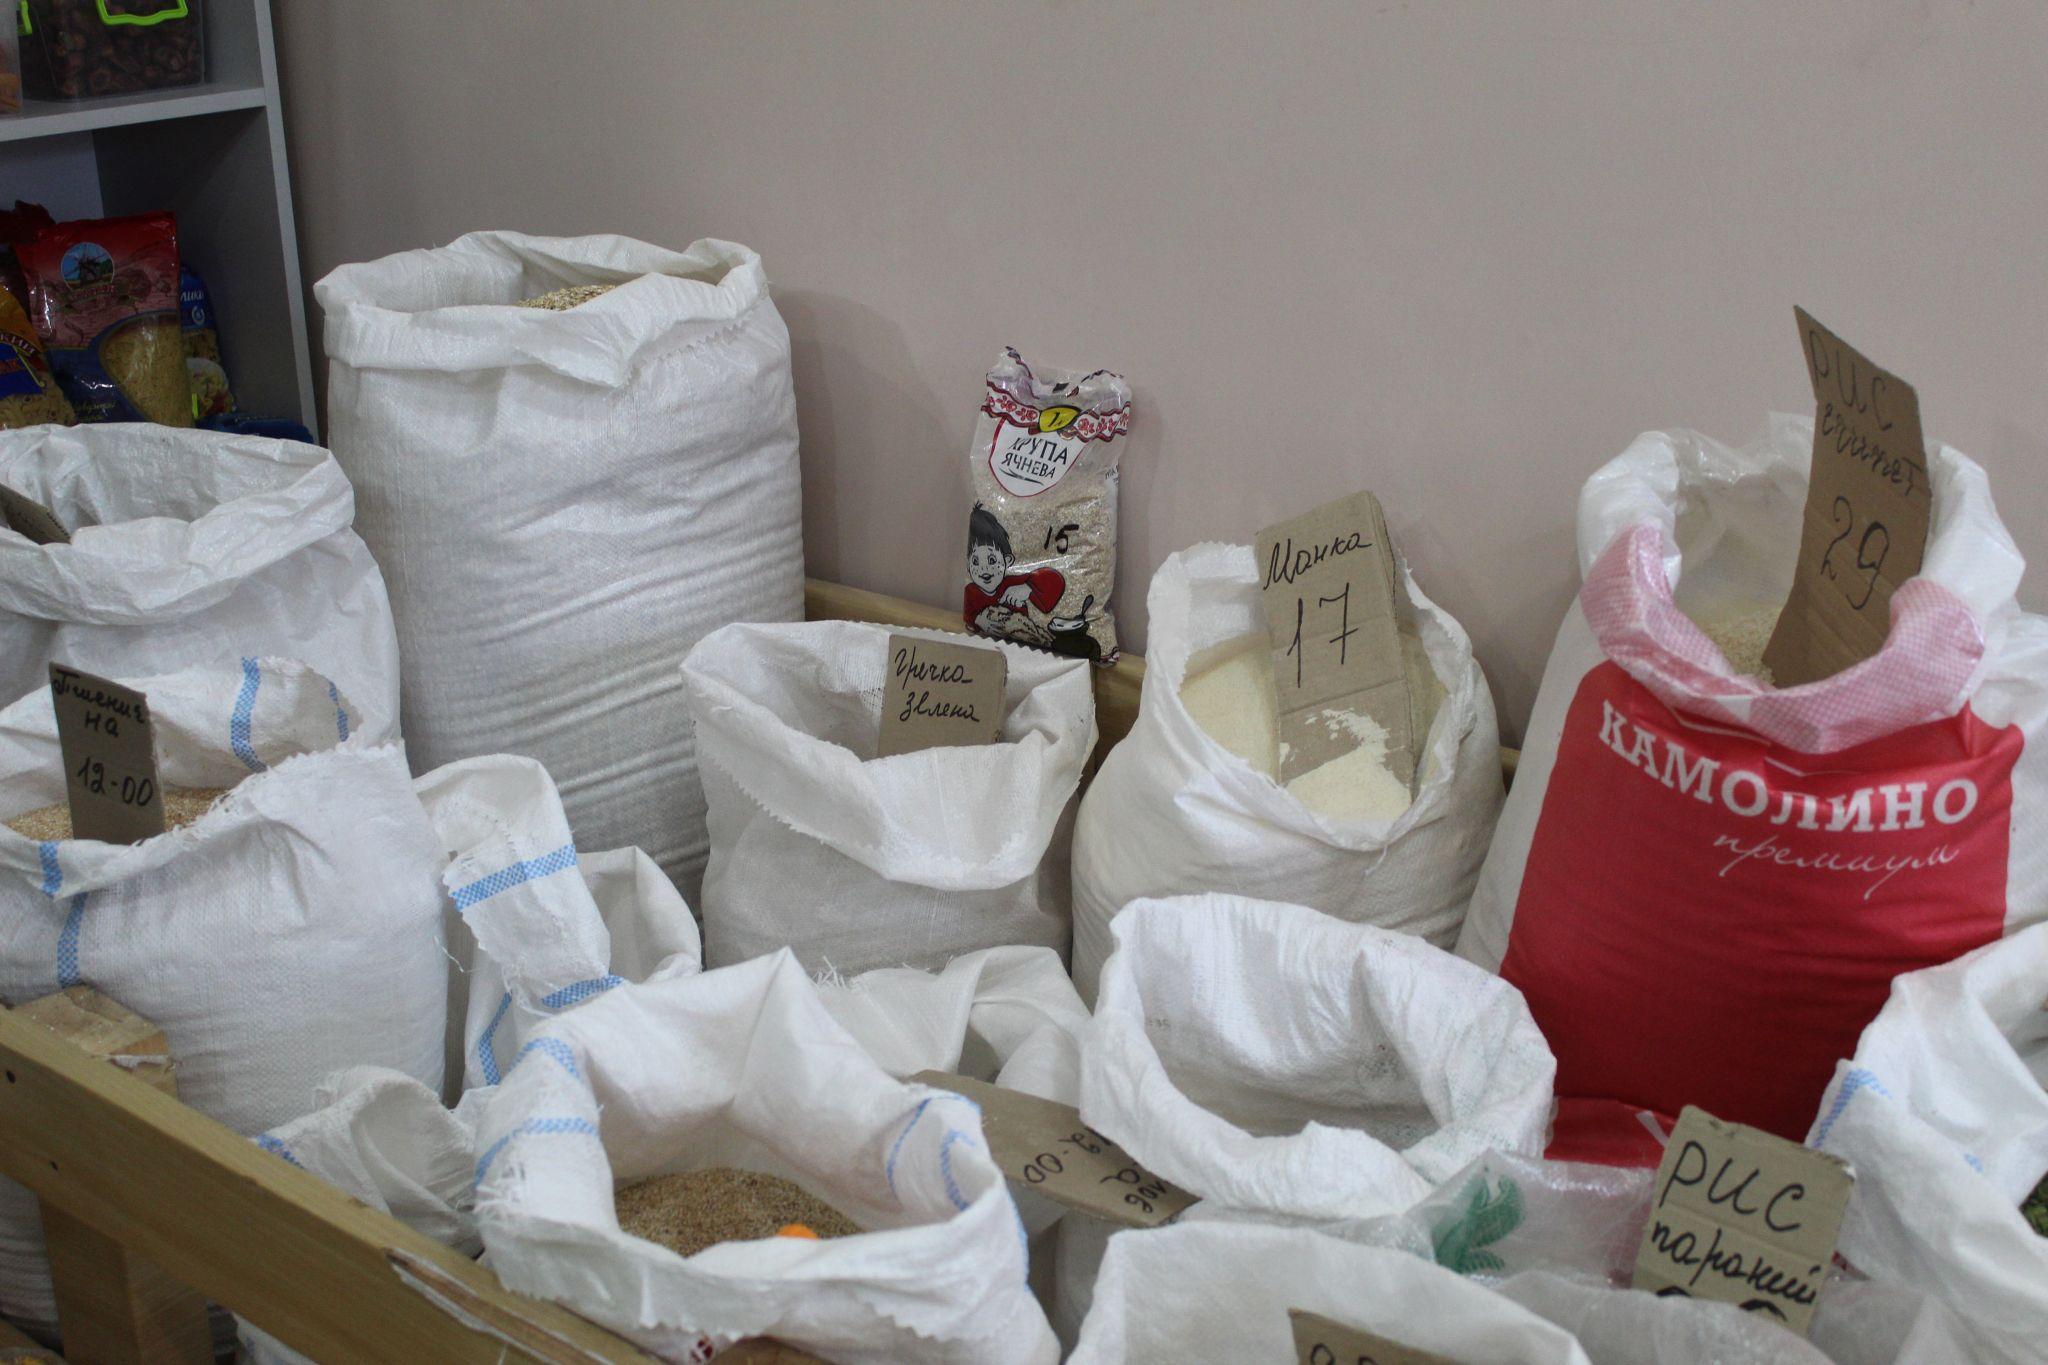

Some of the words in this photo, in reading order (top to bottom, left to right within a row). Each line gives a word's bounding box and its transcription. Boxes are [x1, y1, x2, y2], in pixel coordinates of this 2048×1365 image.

[1000, 452, 1057, 480] ЯЧНЕВА
[1043, 523, 1080, 555] 15
[1262, 531, 1374, 591] Манка
[1820, 495, 1890, 611] 29
[1286, 582, 1359, 689] 17
[76, 756, 154, 807] 12-00
[1599, 699, 1979, 833] КАМОЛИНО
[1713, 829, 1961, 900] премиум
[1658, 1140, 1805, 1232] РИС
